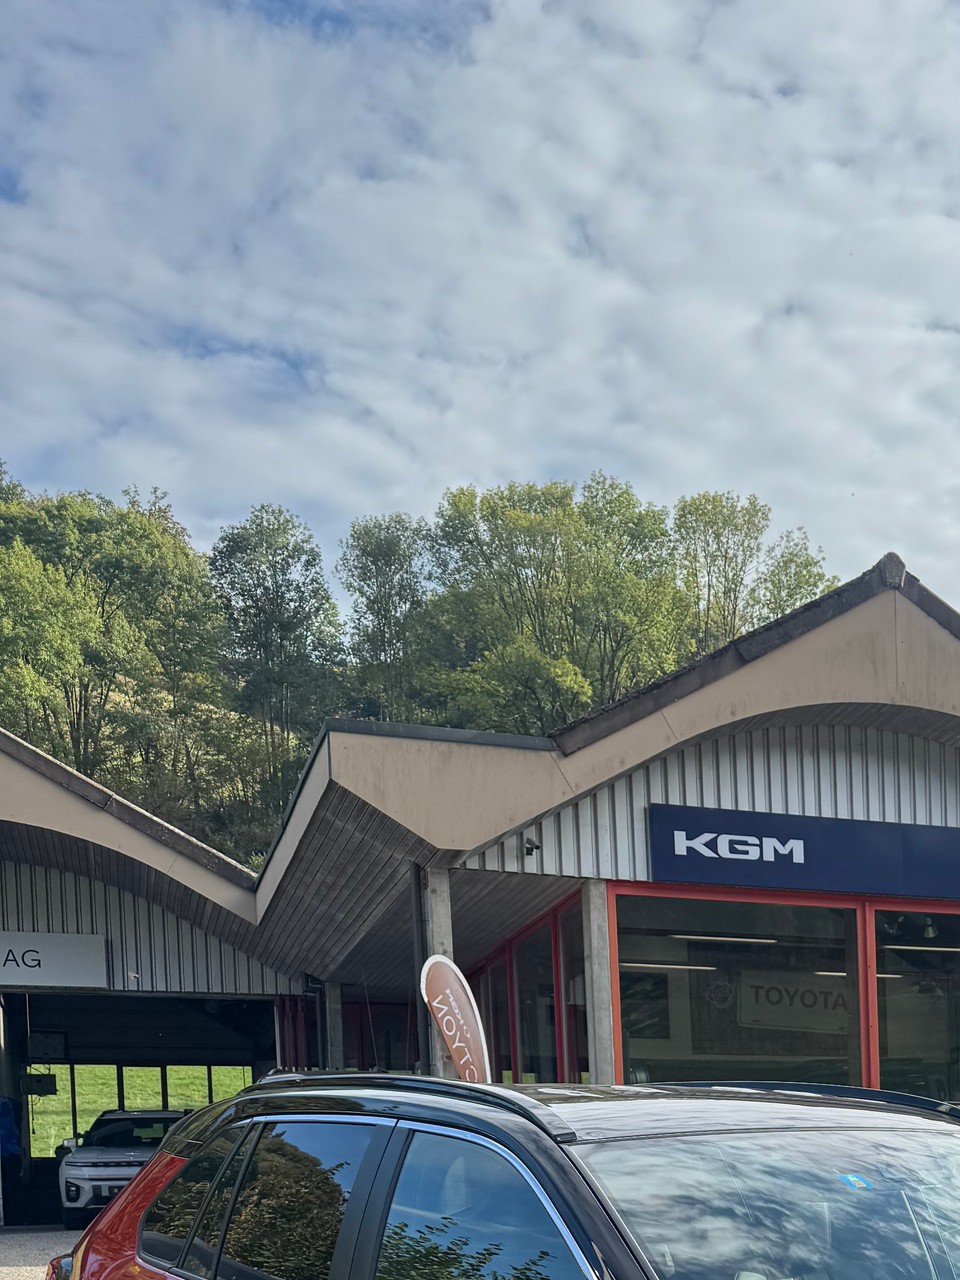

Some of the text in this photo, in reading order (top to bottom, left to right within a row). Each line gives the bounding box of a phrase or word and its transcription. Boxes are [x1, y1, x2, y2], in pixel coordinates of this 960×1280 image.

[674, 830, 804, 863] KGM
[2, 949, 41, 968] AG
[750, 985, 848, 1011] TOYOTA
